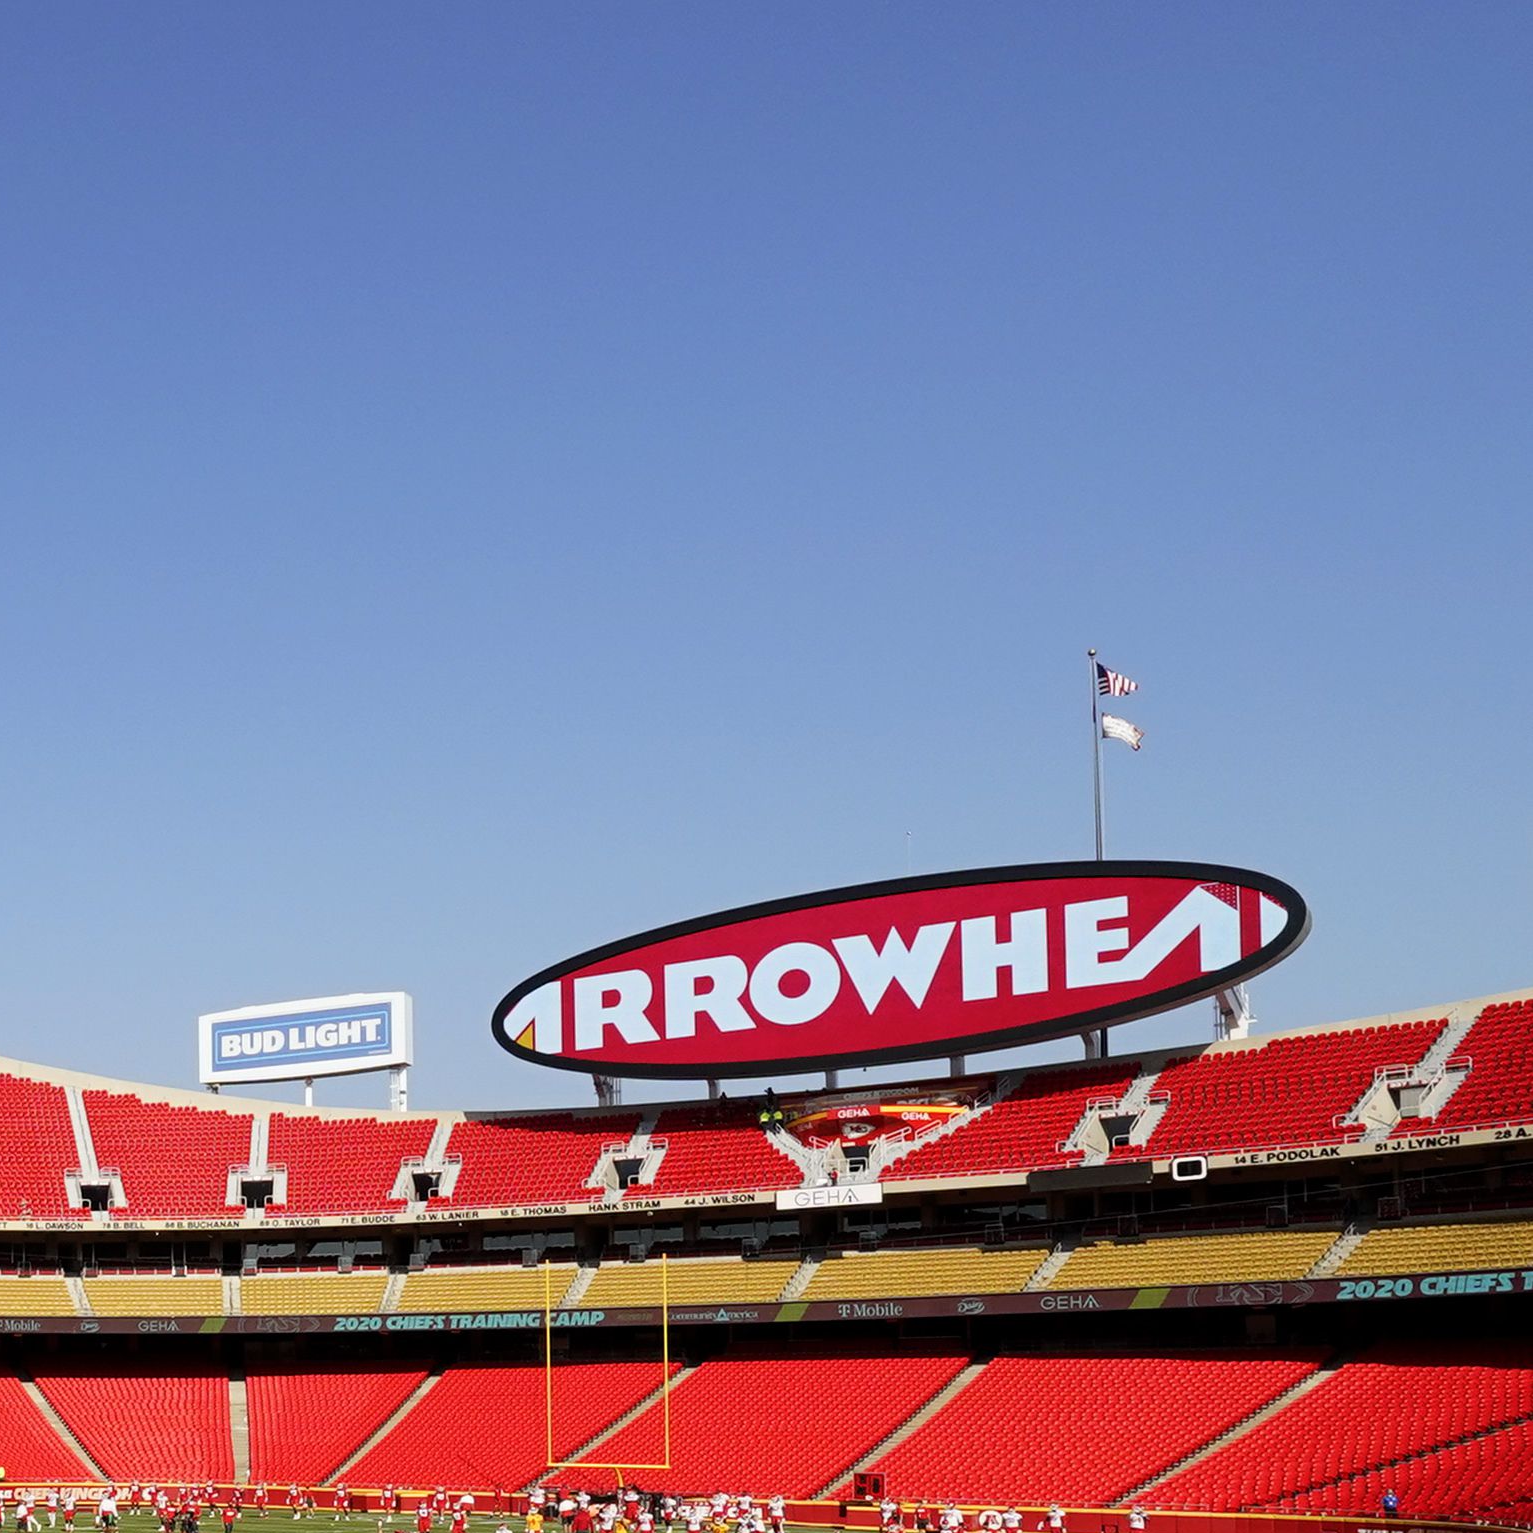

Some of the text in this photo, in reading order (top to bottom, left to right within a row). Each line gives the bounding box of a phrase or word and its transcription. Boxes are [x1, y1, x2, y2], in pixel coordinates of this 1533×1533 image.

[221, 1018, 381, 1058] BUD LIGHT
[837, 1107, 870, 1119] GEHA
[901, 1111, 930, 1121] GEHA
[1494, 1126, 1531, 1141] 28 A.
[1374, 1134, 1461, 1152] 51 J. LYNCH
[1234, 1146, 1340, 1165] 14 E. PODOLAK
[711, 1193, 756, 1205] WILSON
[794, 1187, 859, 1207] GEHA
[523, 1205, 568, 1216] THOMAS
[588, 1199, 661, 1213] HANK STRAM
[361, 1214, 396, 1225] BUDDE
[440, 1210, 480, 1221] LANIER
[44, 1221, 84, 1231] DAWSON
[123, 1220, 146, 1230] BELL
[187, 1219, 241, 1229] BUCHANAN
[283, 1217, 321, 1227] TAYLOR
[1336, 1278, 1414, 1300] 2020
[1419, 1272, 1516, 1296] CHIEFS
[1040, 1294, 1099, 1311] GEHA
[137, 1319, 180, 1332] GEHA
[334, 1317, 383, 1332] 2020
[385, 1314, 443, 1330] CHIEFS
[450, 1312, 540, 1329] TRAINING
[544, 1311, 606, 1327] CAMP
